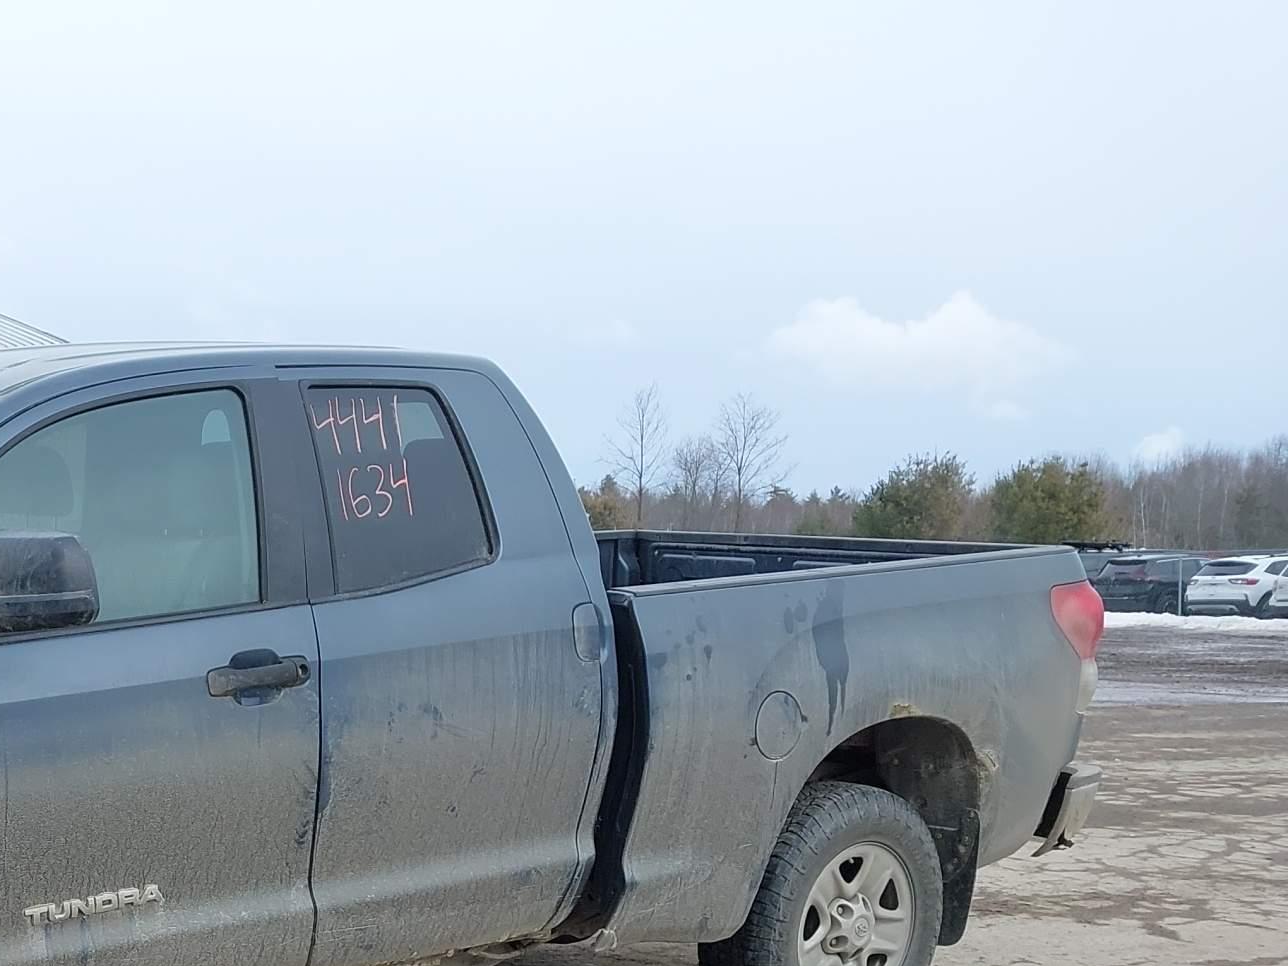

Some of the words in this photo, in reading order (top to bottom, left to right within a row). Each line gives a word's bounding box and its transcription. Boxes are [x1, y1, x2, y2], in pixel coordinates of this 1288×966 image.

[309, 394, 402, 456] 4441
[336, 458, 414, 521] 1634
[23, 883, 165, 927] TUNDRA
